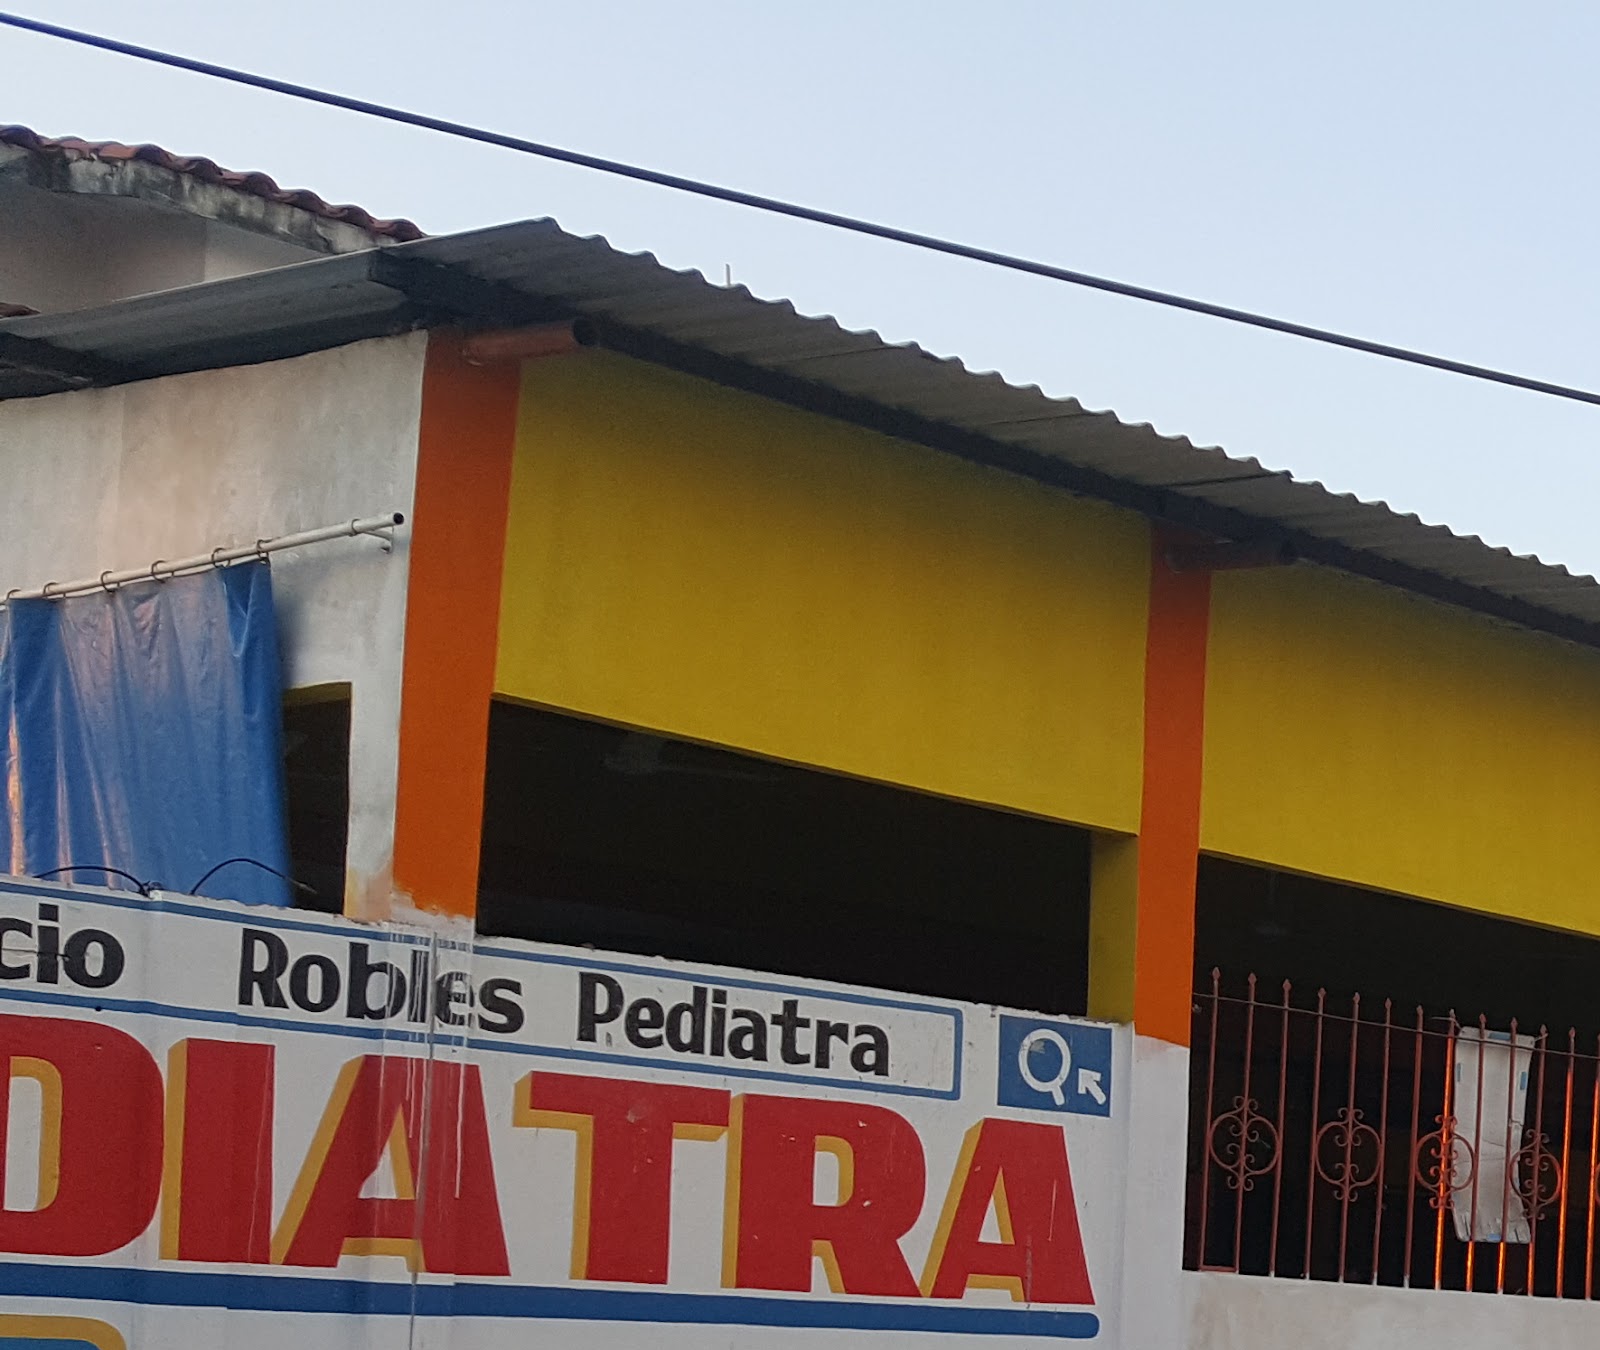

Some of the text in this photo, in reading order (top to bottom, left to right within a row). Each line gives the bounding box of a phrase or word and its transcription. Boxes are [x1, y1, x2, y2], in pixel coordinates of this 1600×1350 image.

[238, 928, 525, 1034] Robles
[576, 971, 890, 1077] Pediatra
[0, 1012, 1096, 1305] DIATRA
